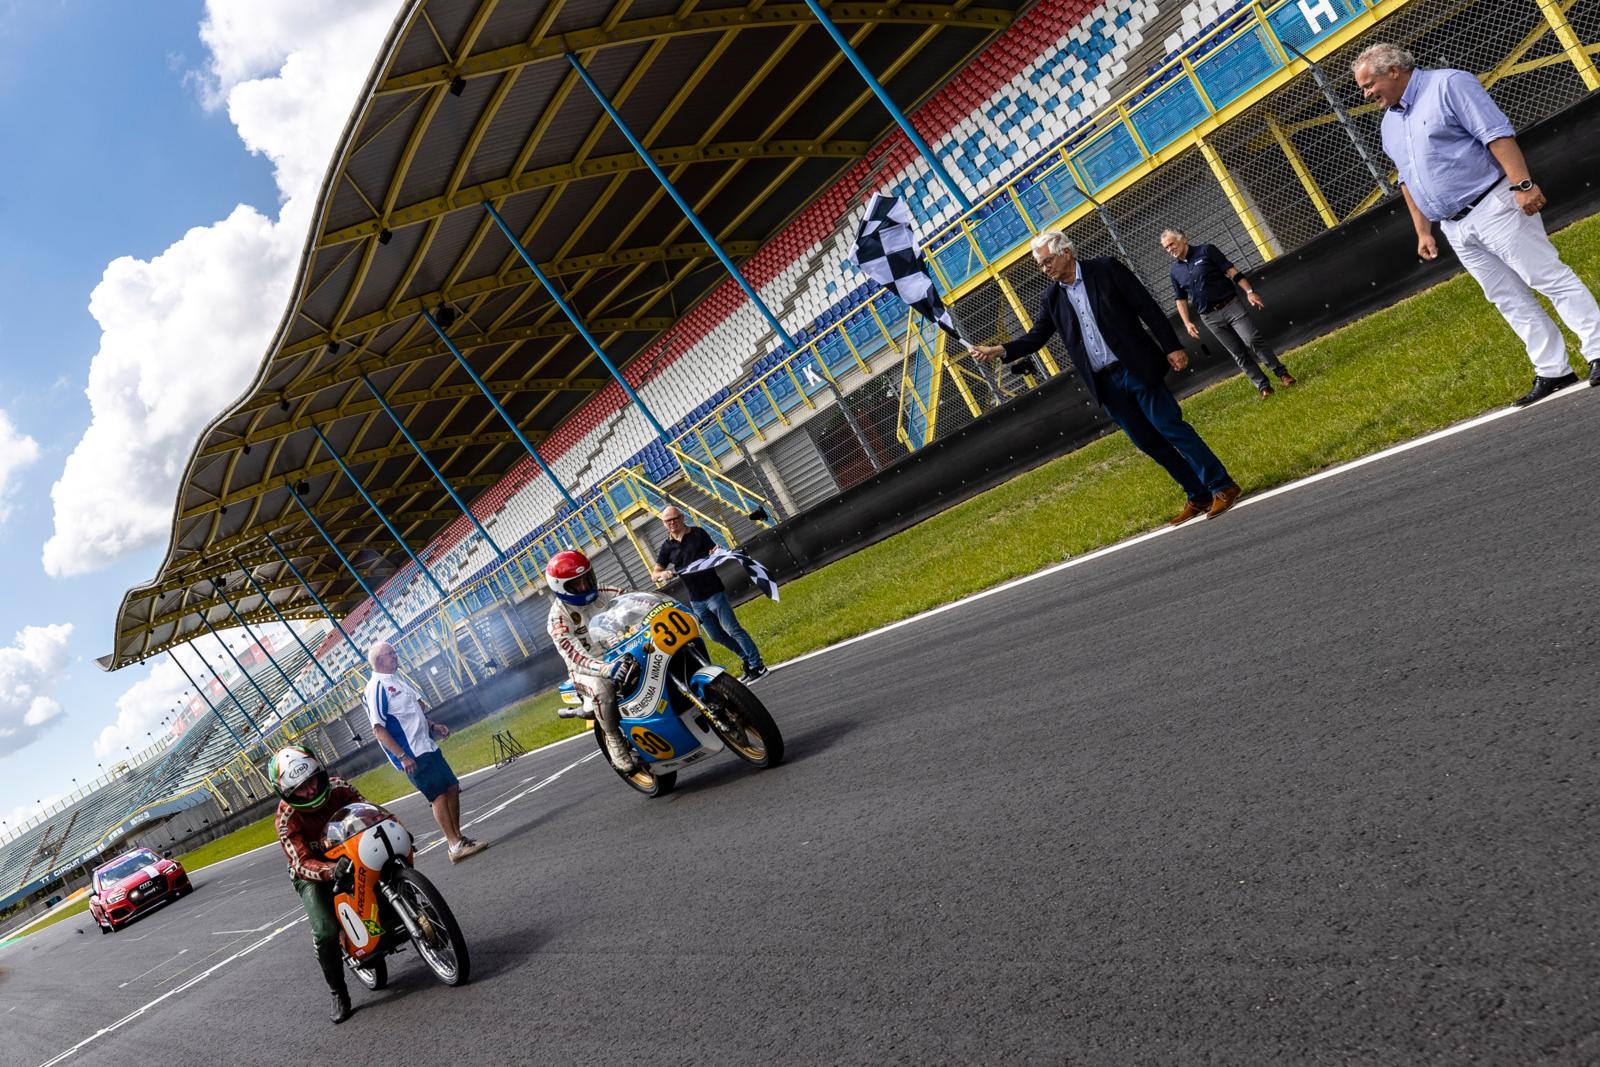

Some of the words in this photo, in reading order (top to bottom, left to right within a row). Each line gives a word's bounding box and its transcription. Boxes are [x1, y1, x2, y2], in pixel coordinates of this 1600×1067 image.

[1297, 0, 1338, 35] H
[803, 364, 822, 387] K
[642, 601, 674, 626] MICHELIN
[653, 611, 691, 646] 30
[629, 686, 656, 715] RIEMERSMA
[651, 654, 663, 680] NIMAG
[631, 731, 672, 755] 30
[373, 825, 395, 859] 1
[40, 874, 50, 884] TT
[53, 858, 80, 877] CIRCUIT
[357, 866, 367, 918] KREIDLER
[341, 909, 360, 941] 1
